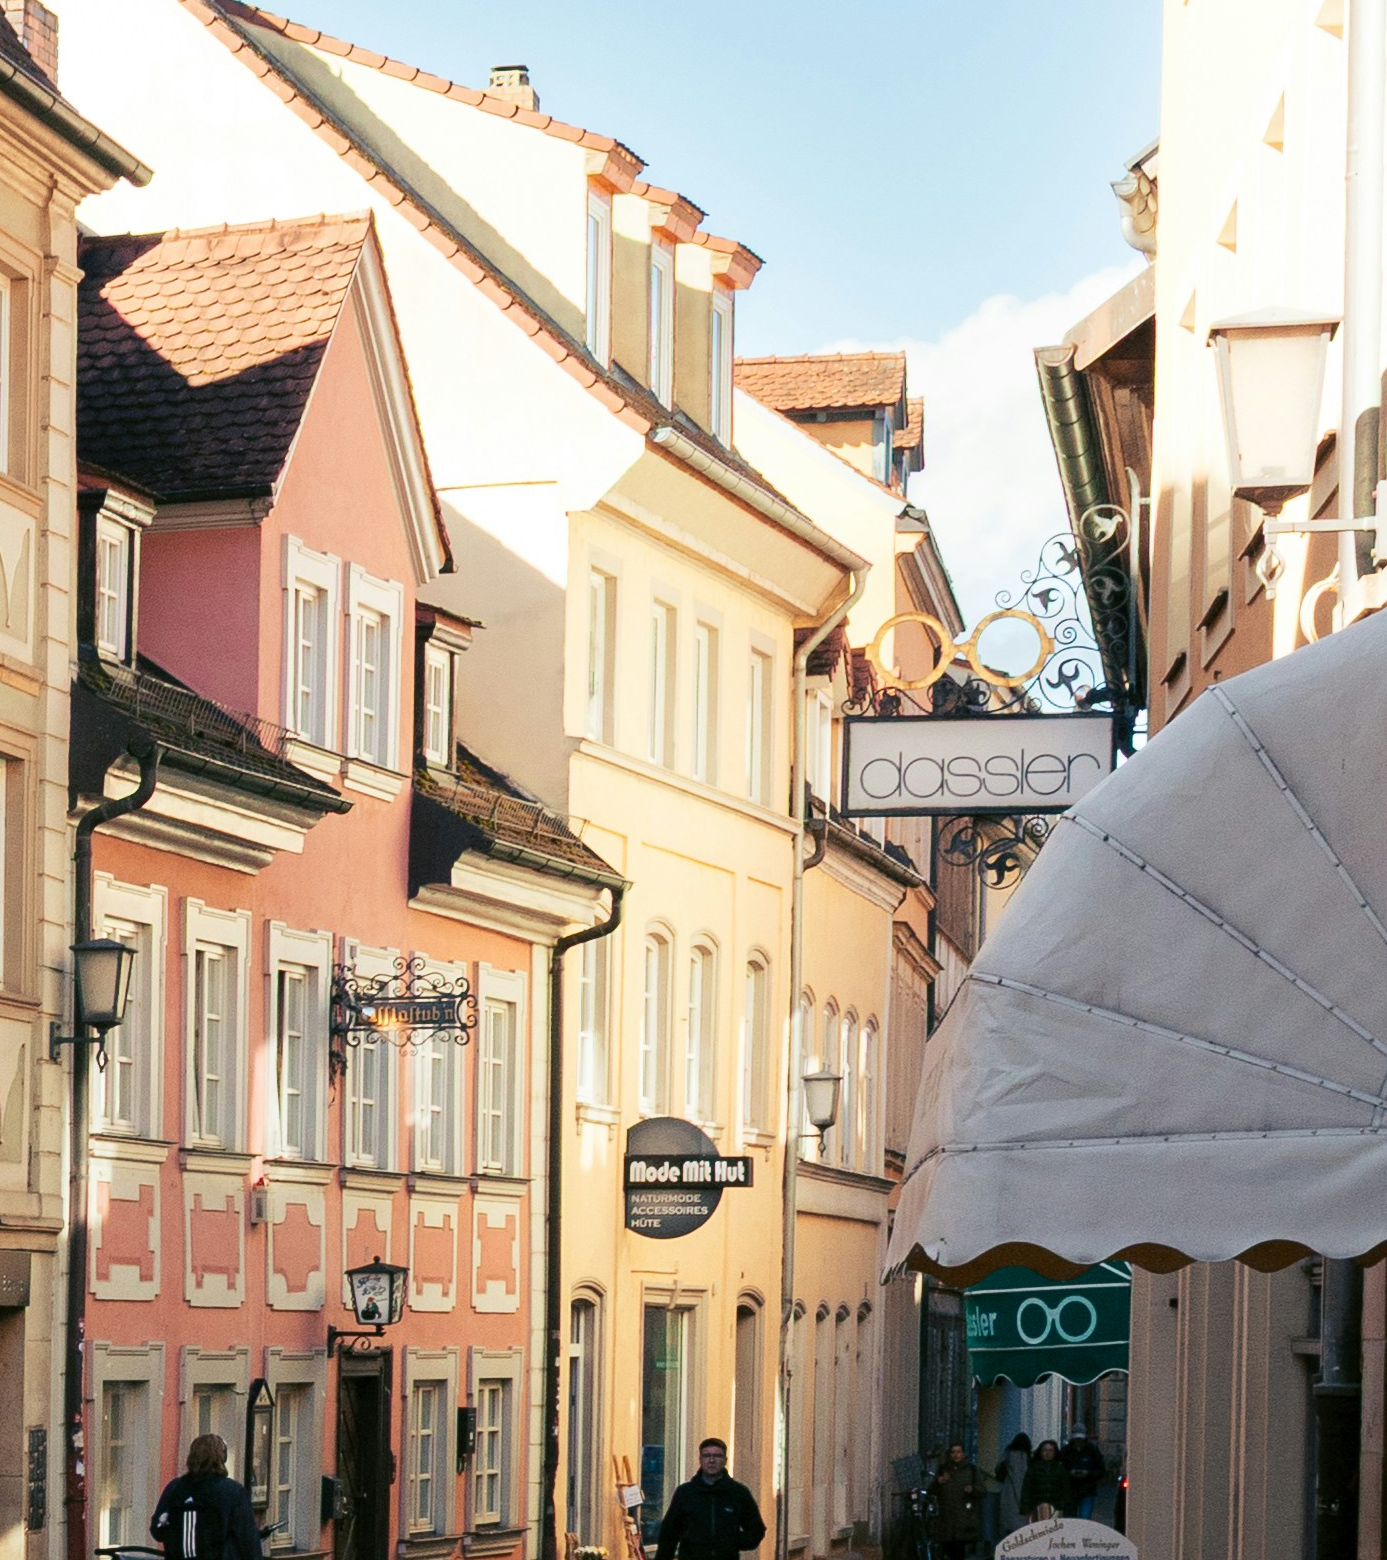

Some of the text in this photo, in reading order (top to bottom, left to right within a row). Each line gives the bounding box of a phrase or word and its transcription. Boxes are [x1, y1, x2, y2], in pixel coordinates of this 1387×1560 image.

[860, 748, 1101, 799] dassler
[629, 1160, 745, 1183] Mode Mit Hut
[631, 1194, 701, 1203] NATURMODE
[631, 1206, 709, 1215] ACCESSOIRES
[631, 1217, 661, 1228] HÜTE
[1002, 1519, 1064, 1553] Goldschmiede
[1047, 1538, 1076, 1551] Jochen
